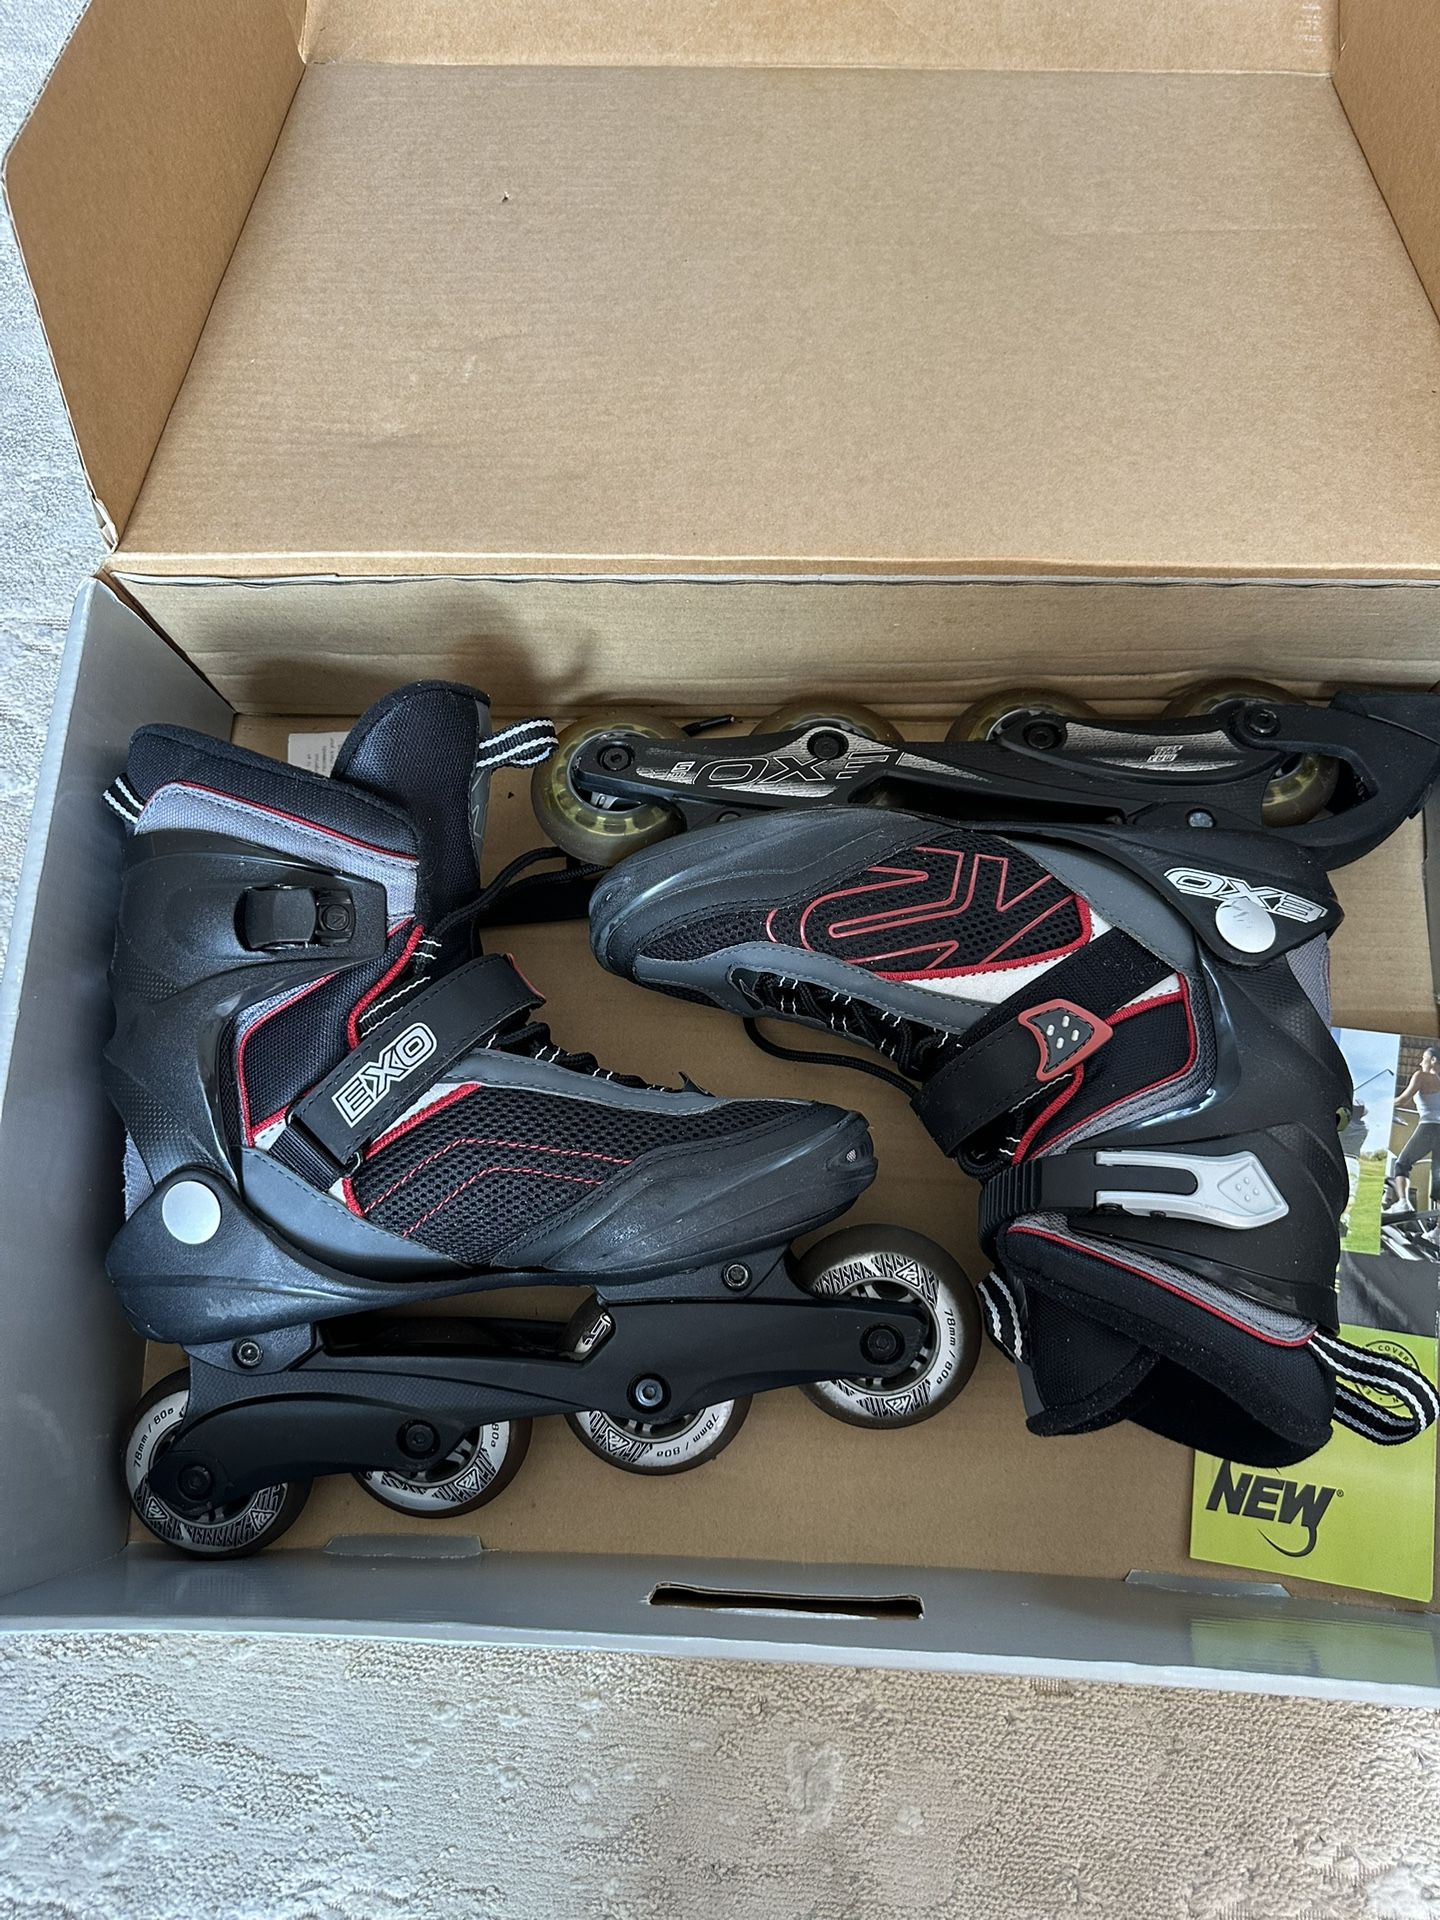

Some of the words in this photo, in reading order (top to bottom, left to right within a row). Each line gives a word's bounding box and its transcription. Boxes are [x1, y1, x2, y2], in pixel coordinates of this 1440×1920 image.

[693, 749, 899, 788] EXO
[1163, 867, 1329, 924] EXO
[331, 1022, 438, 1128] EXO
[943, 1308, 957, 1347] 78mm
[935, 1361, 954, 1385] 80a
[132, 1434, 149, 1468] 78mm
[152, 1406, 175, 1425] 80a
[692, 1412, 720, 1443] 78mm
[656, 1446, 681, 1458] 80a
